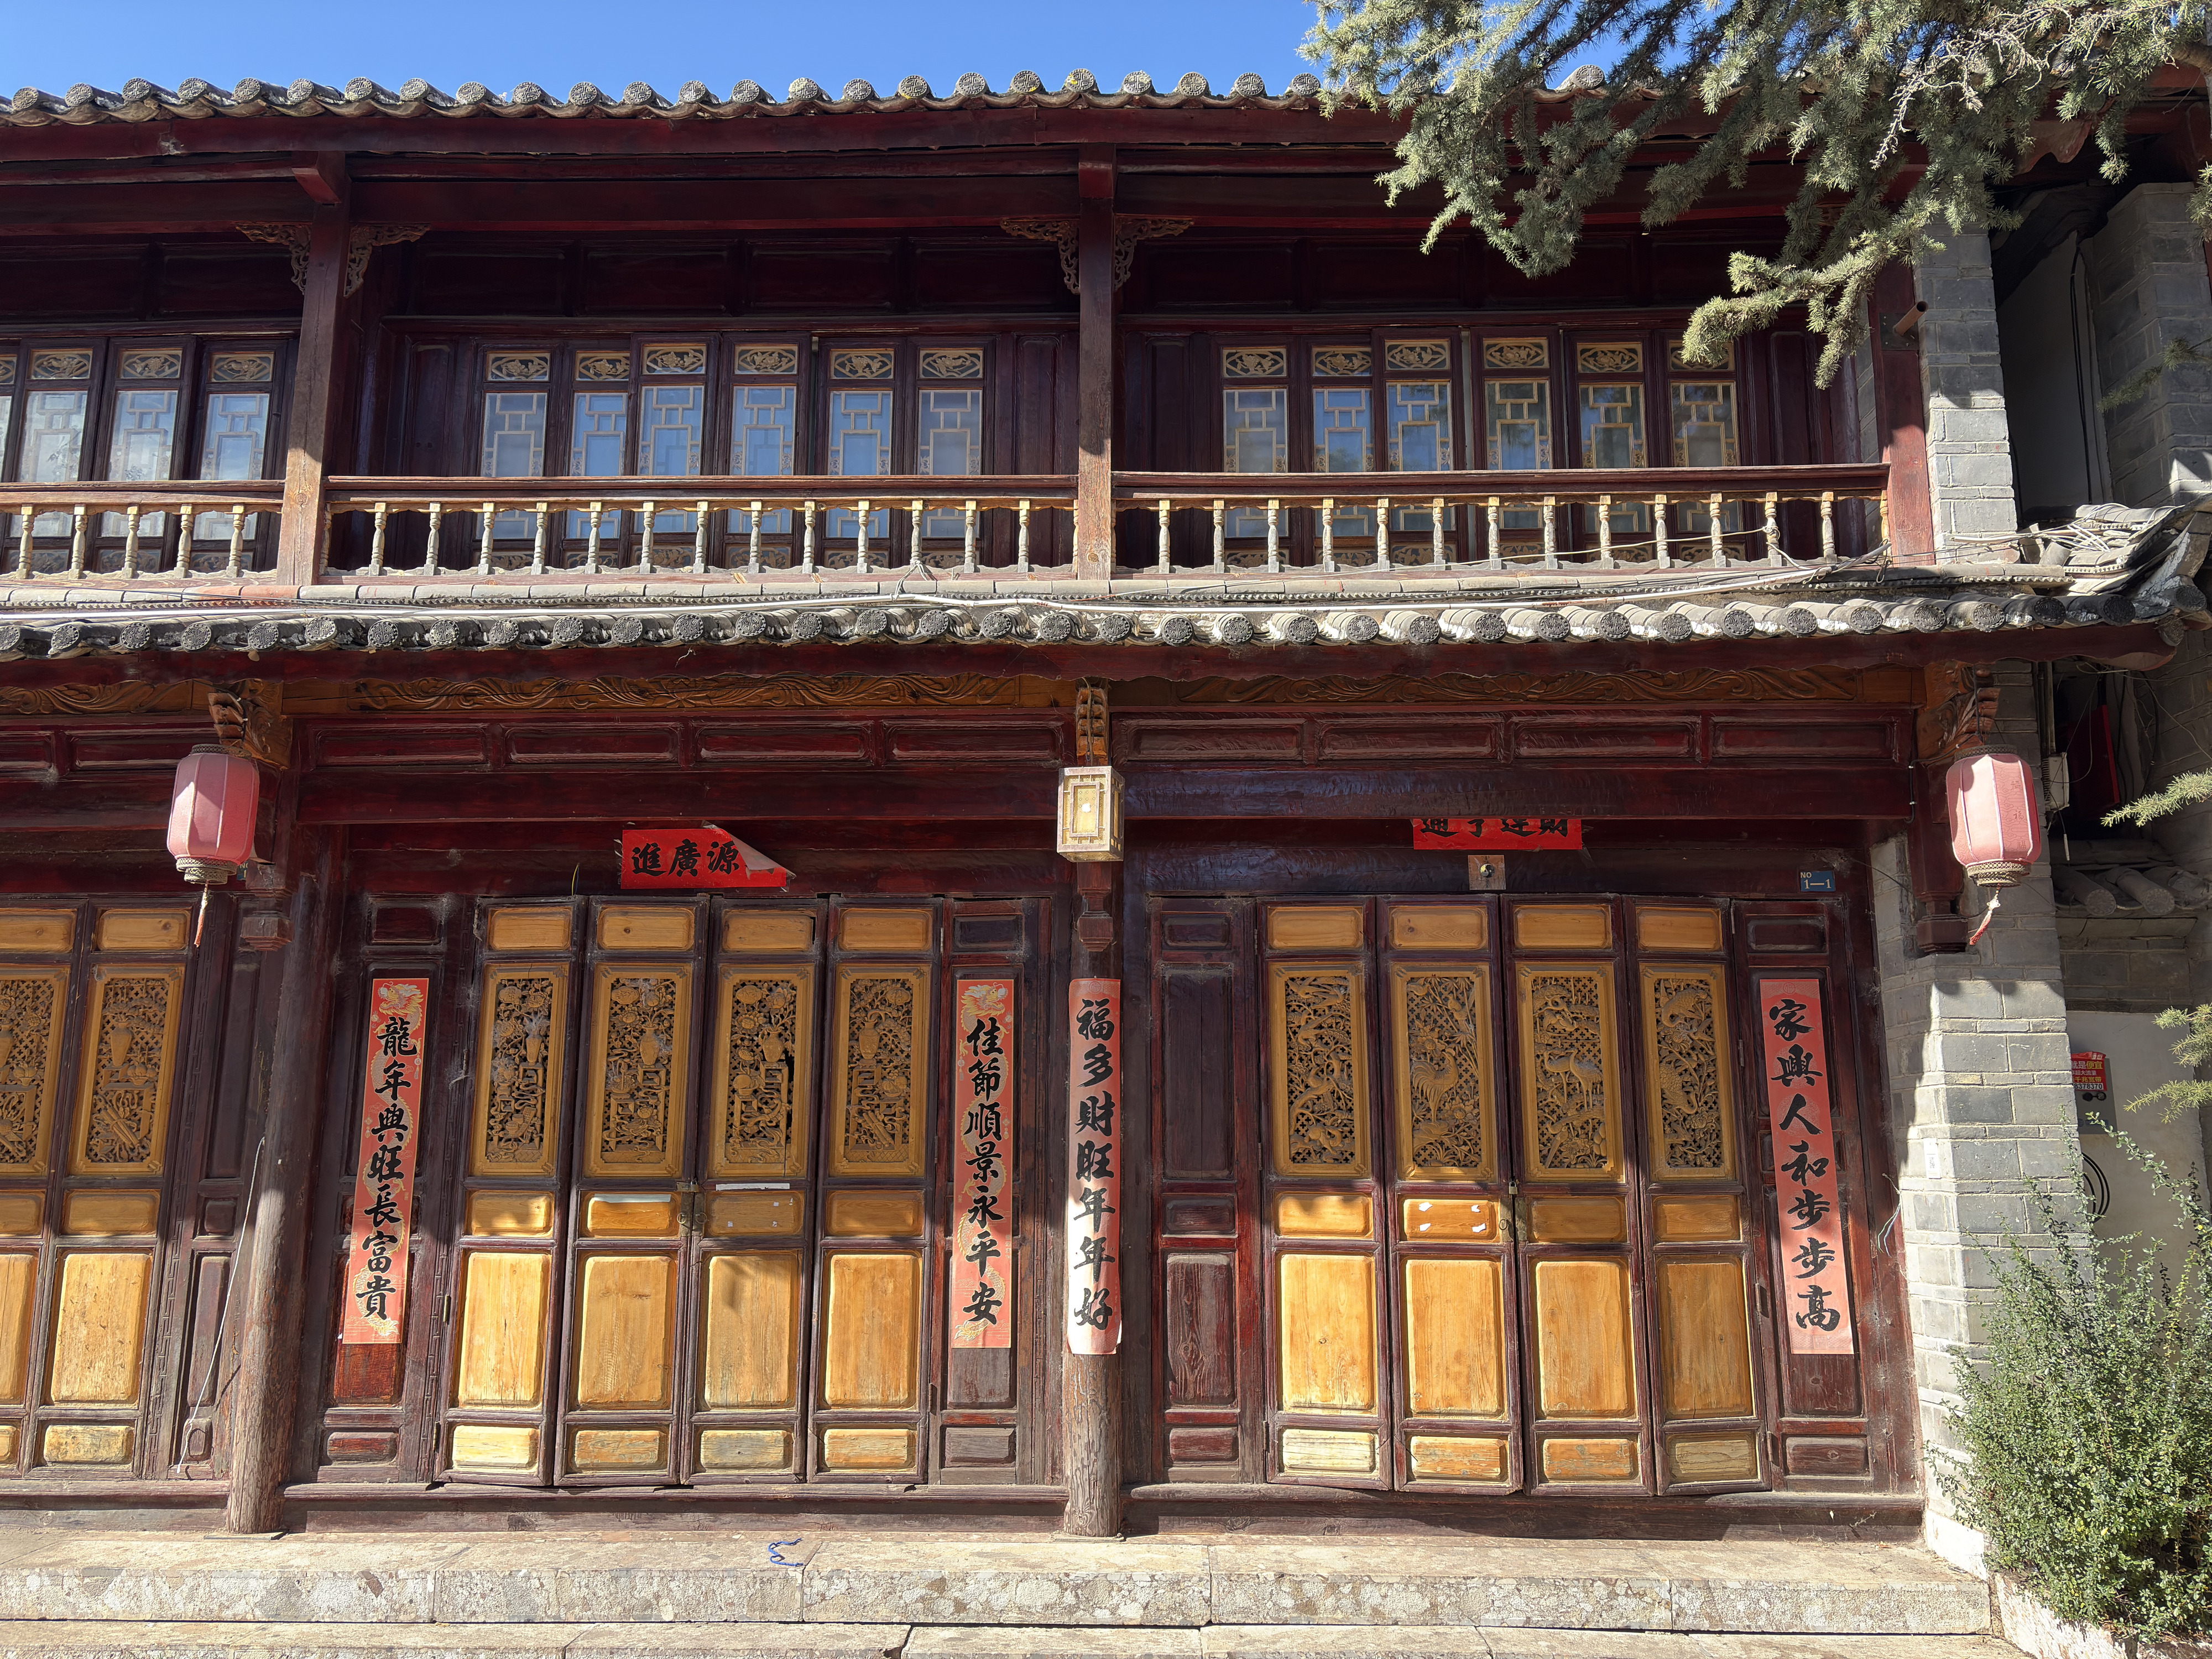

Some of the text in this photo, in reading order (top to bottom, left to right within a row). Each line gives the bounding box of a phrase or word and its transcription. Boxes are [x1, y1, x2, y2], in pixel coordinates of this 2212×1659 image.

[356, 1016, 418, 1320] 龍年興旺長富貴
[963, 1017, 1004, 1325] 佳節順景永平安
[1074, 999, 1116, 1331] 福多財旺年年好
[1769, 999, 1840, 1332] 家興人和步步高
